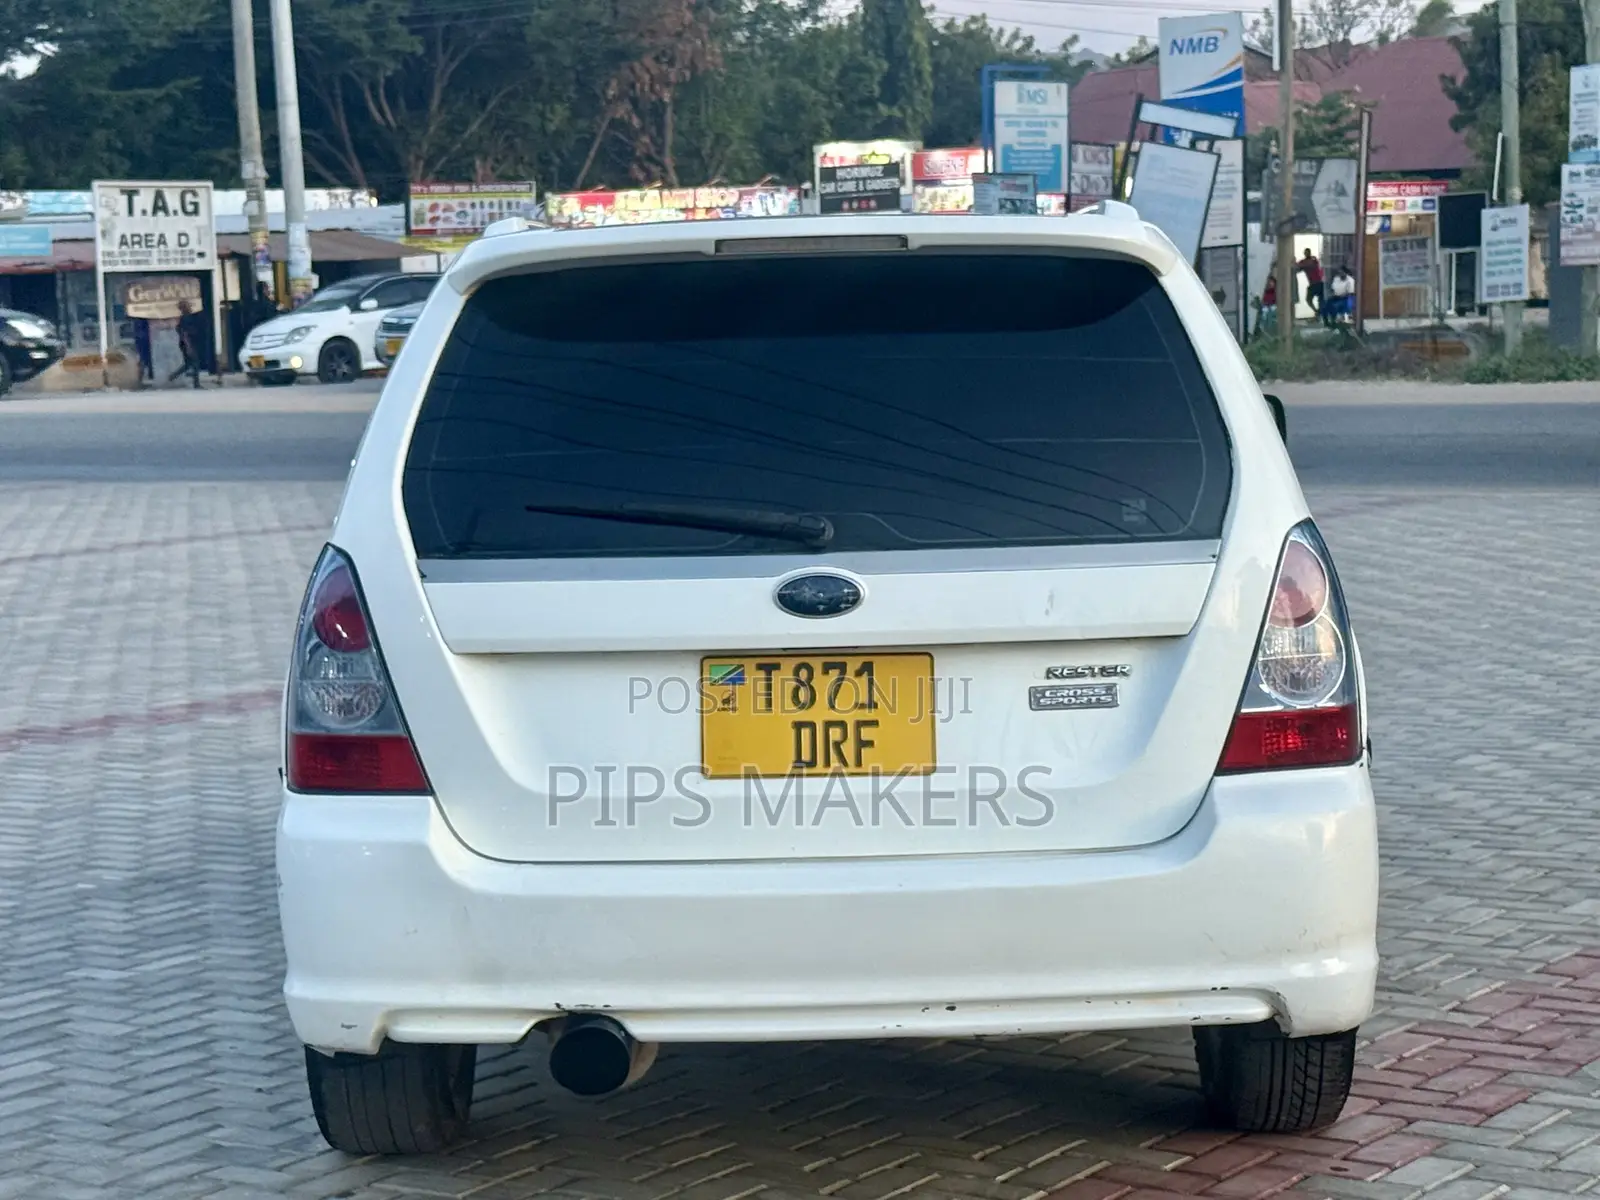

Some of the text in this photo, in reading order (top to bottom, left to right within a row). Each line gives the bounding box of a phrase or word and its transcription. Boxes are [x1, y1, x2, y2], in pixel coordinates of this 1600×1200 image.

[1168, 36, 1220, 56] NMB
[119, 188, 200, 218] T.A.G
[119, 232, 190, 249] AREA D
[1044, 664, 1131, 680] RESTER
[1039, 696, 1113, 706] SPORTS
[1044, 687, 1107, 698] CROSS
[791, 719, 880, 768] DRF
